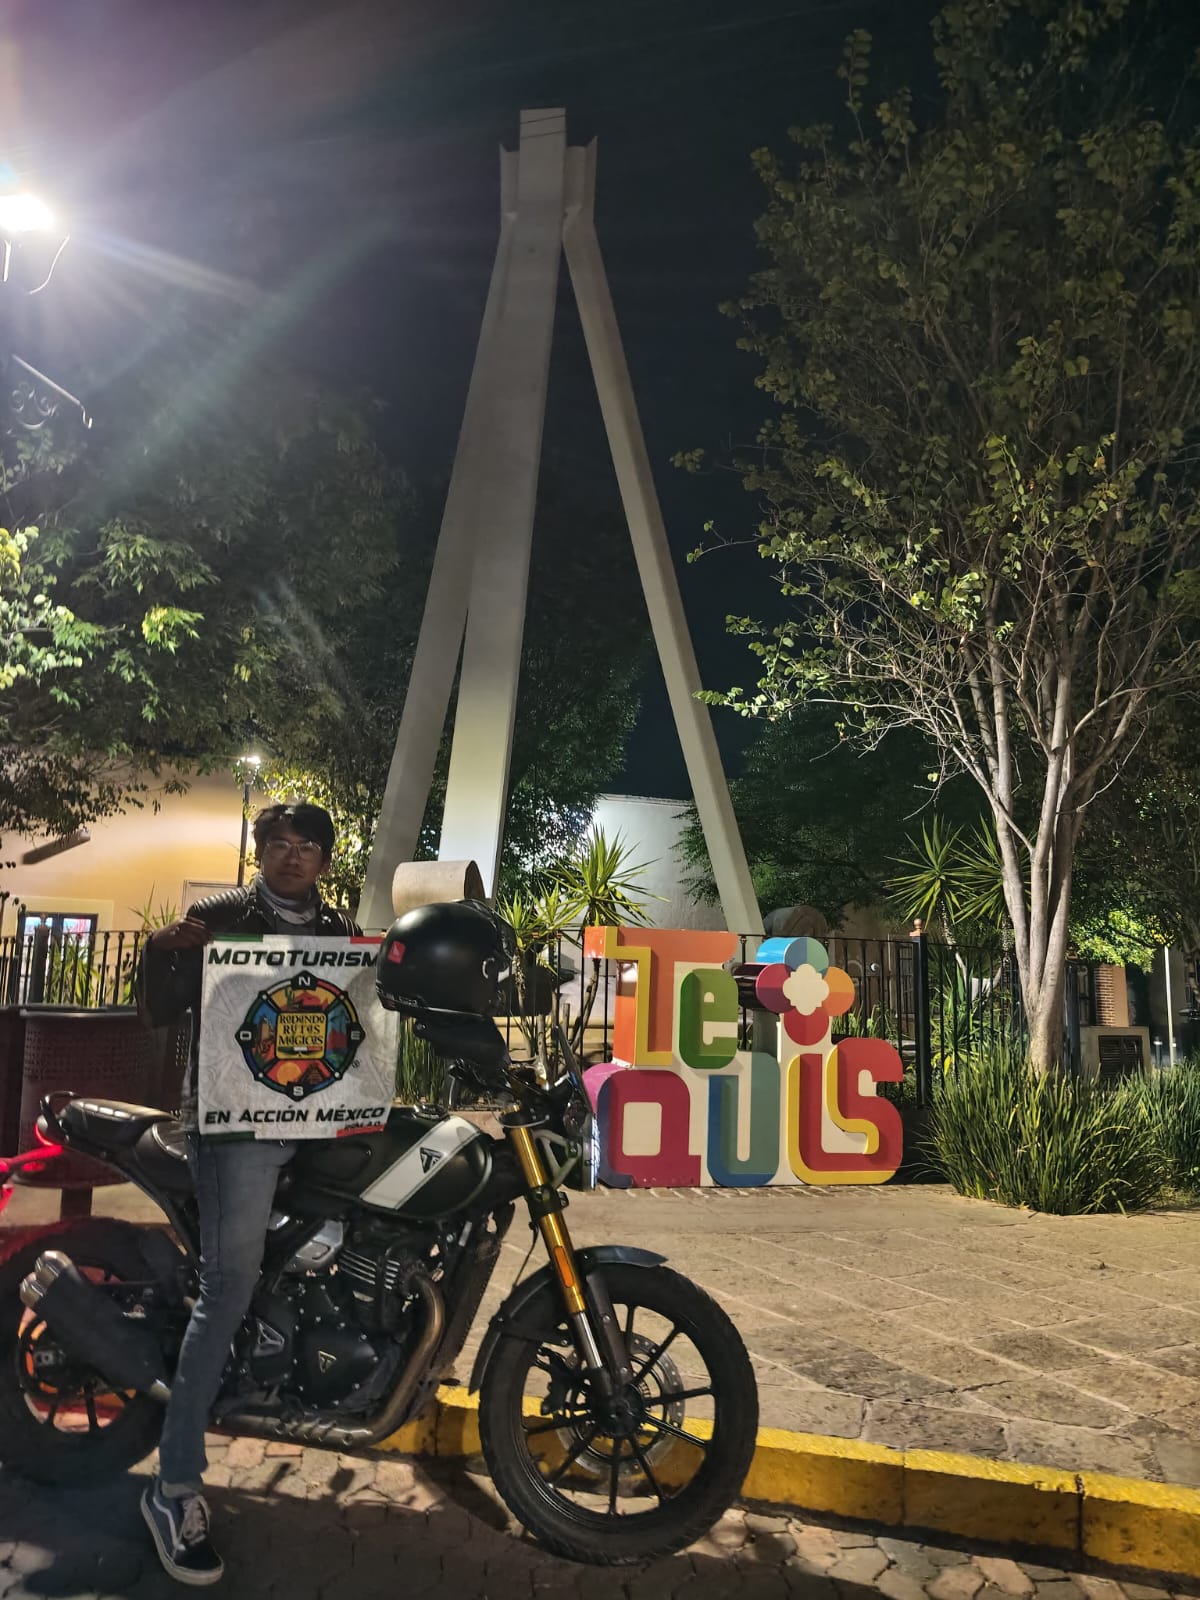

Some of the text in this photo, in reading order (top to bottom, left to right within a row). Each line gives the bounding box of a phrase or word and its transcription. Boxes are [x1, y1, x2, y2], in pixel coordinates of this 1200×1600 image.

[207, 948, 378, 967] MOTOTURISM
[298, 976, 311, 986] N
[293, 1086, 304, 1096] S
[204, 1104, 386, 1125] EN ACCIÓN MÉXICO
